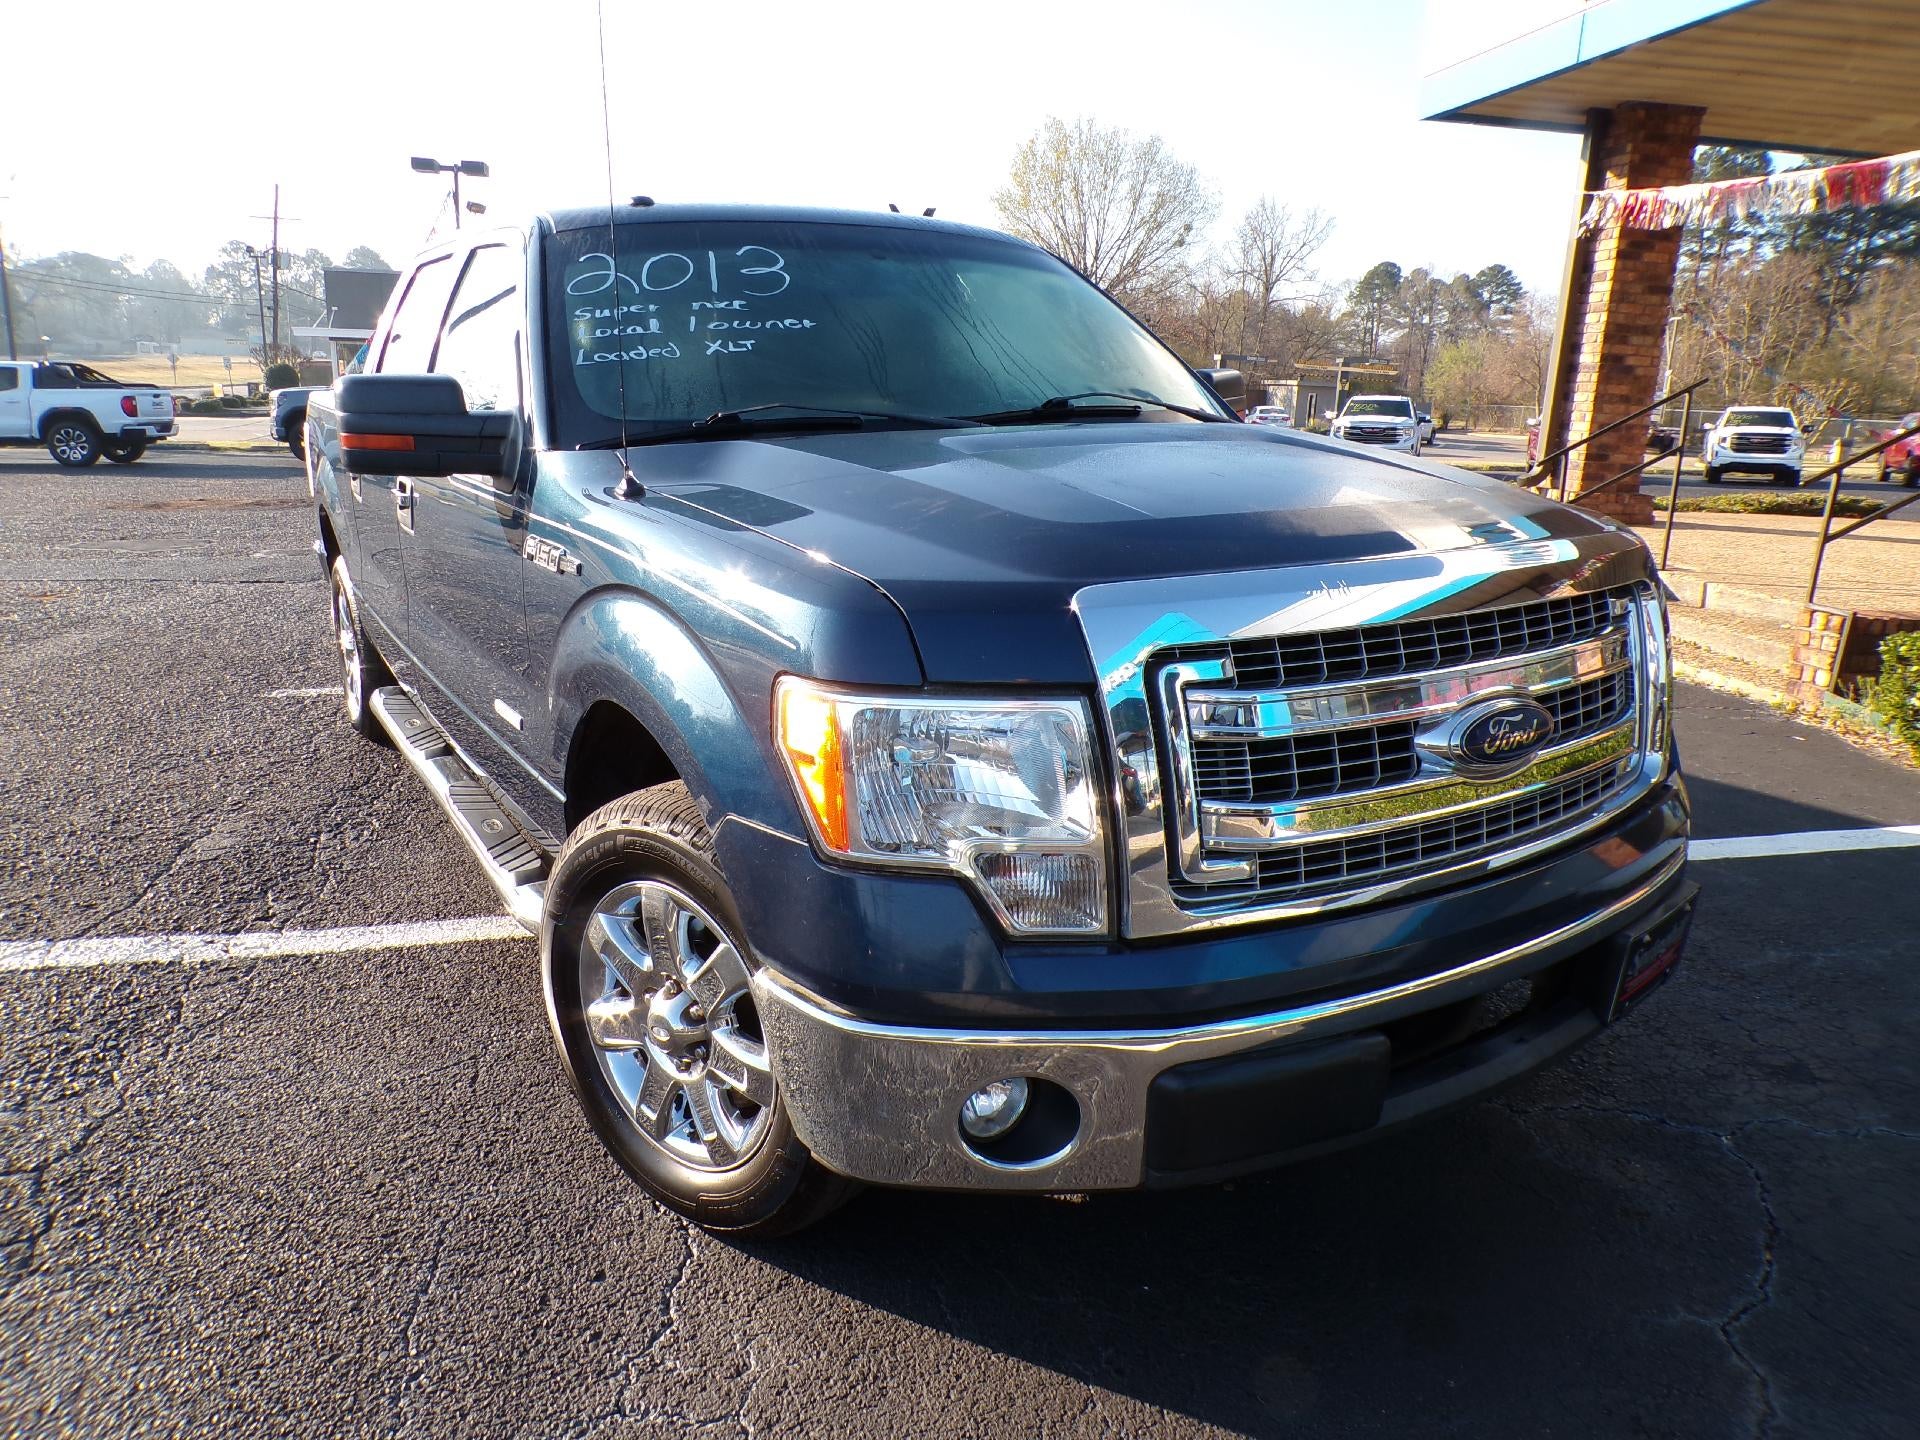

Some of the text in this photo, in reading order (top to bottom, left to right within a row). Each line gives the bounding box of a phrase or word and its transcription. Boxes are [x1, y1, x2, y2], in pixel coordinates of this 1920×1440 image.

[566, 245, 790, 296] 2013
[574, 304, 660, 321] Super
[579, 318, 663, 339] Local
[706, 318, 817, 330] owner
[576, 339, 756, 366] Loaded XLT
[1484, 713, 1538, 755] Ford
[629, 838, 671, 861] DEFENDER
